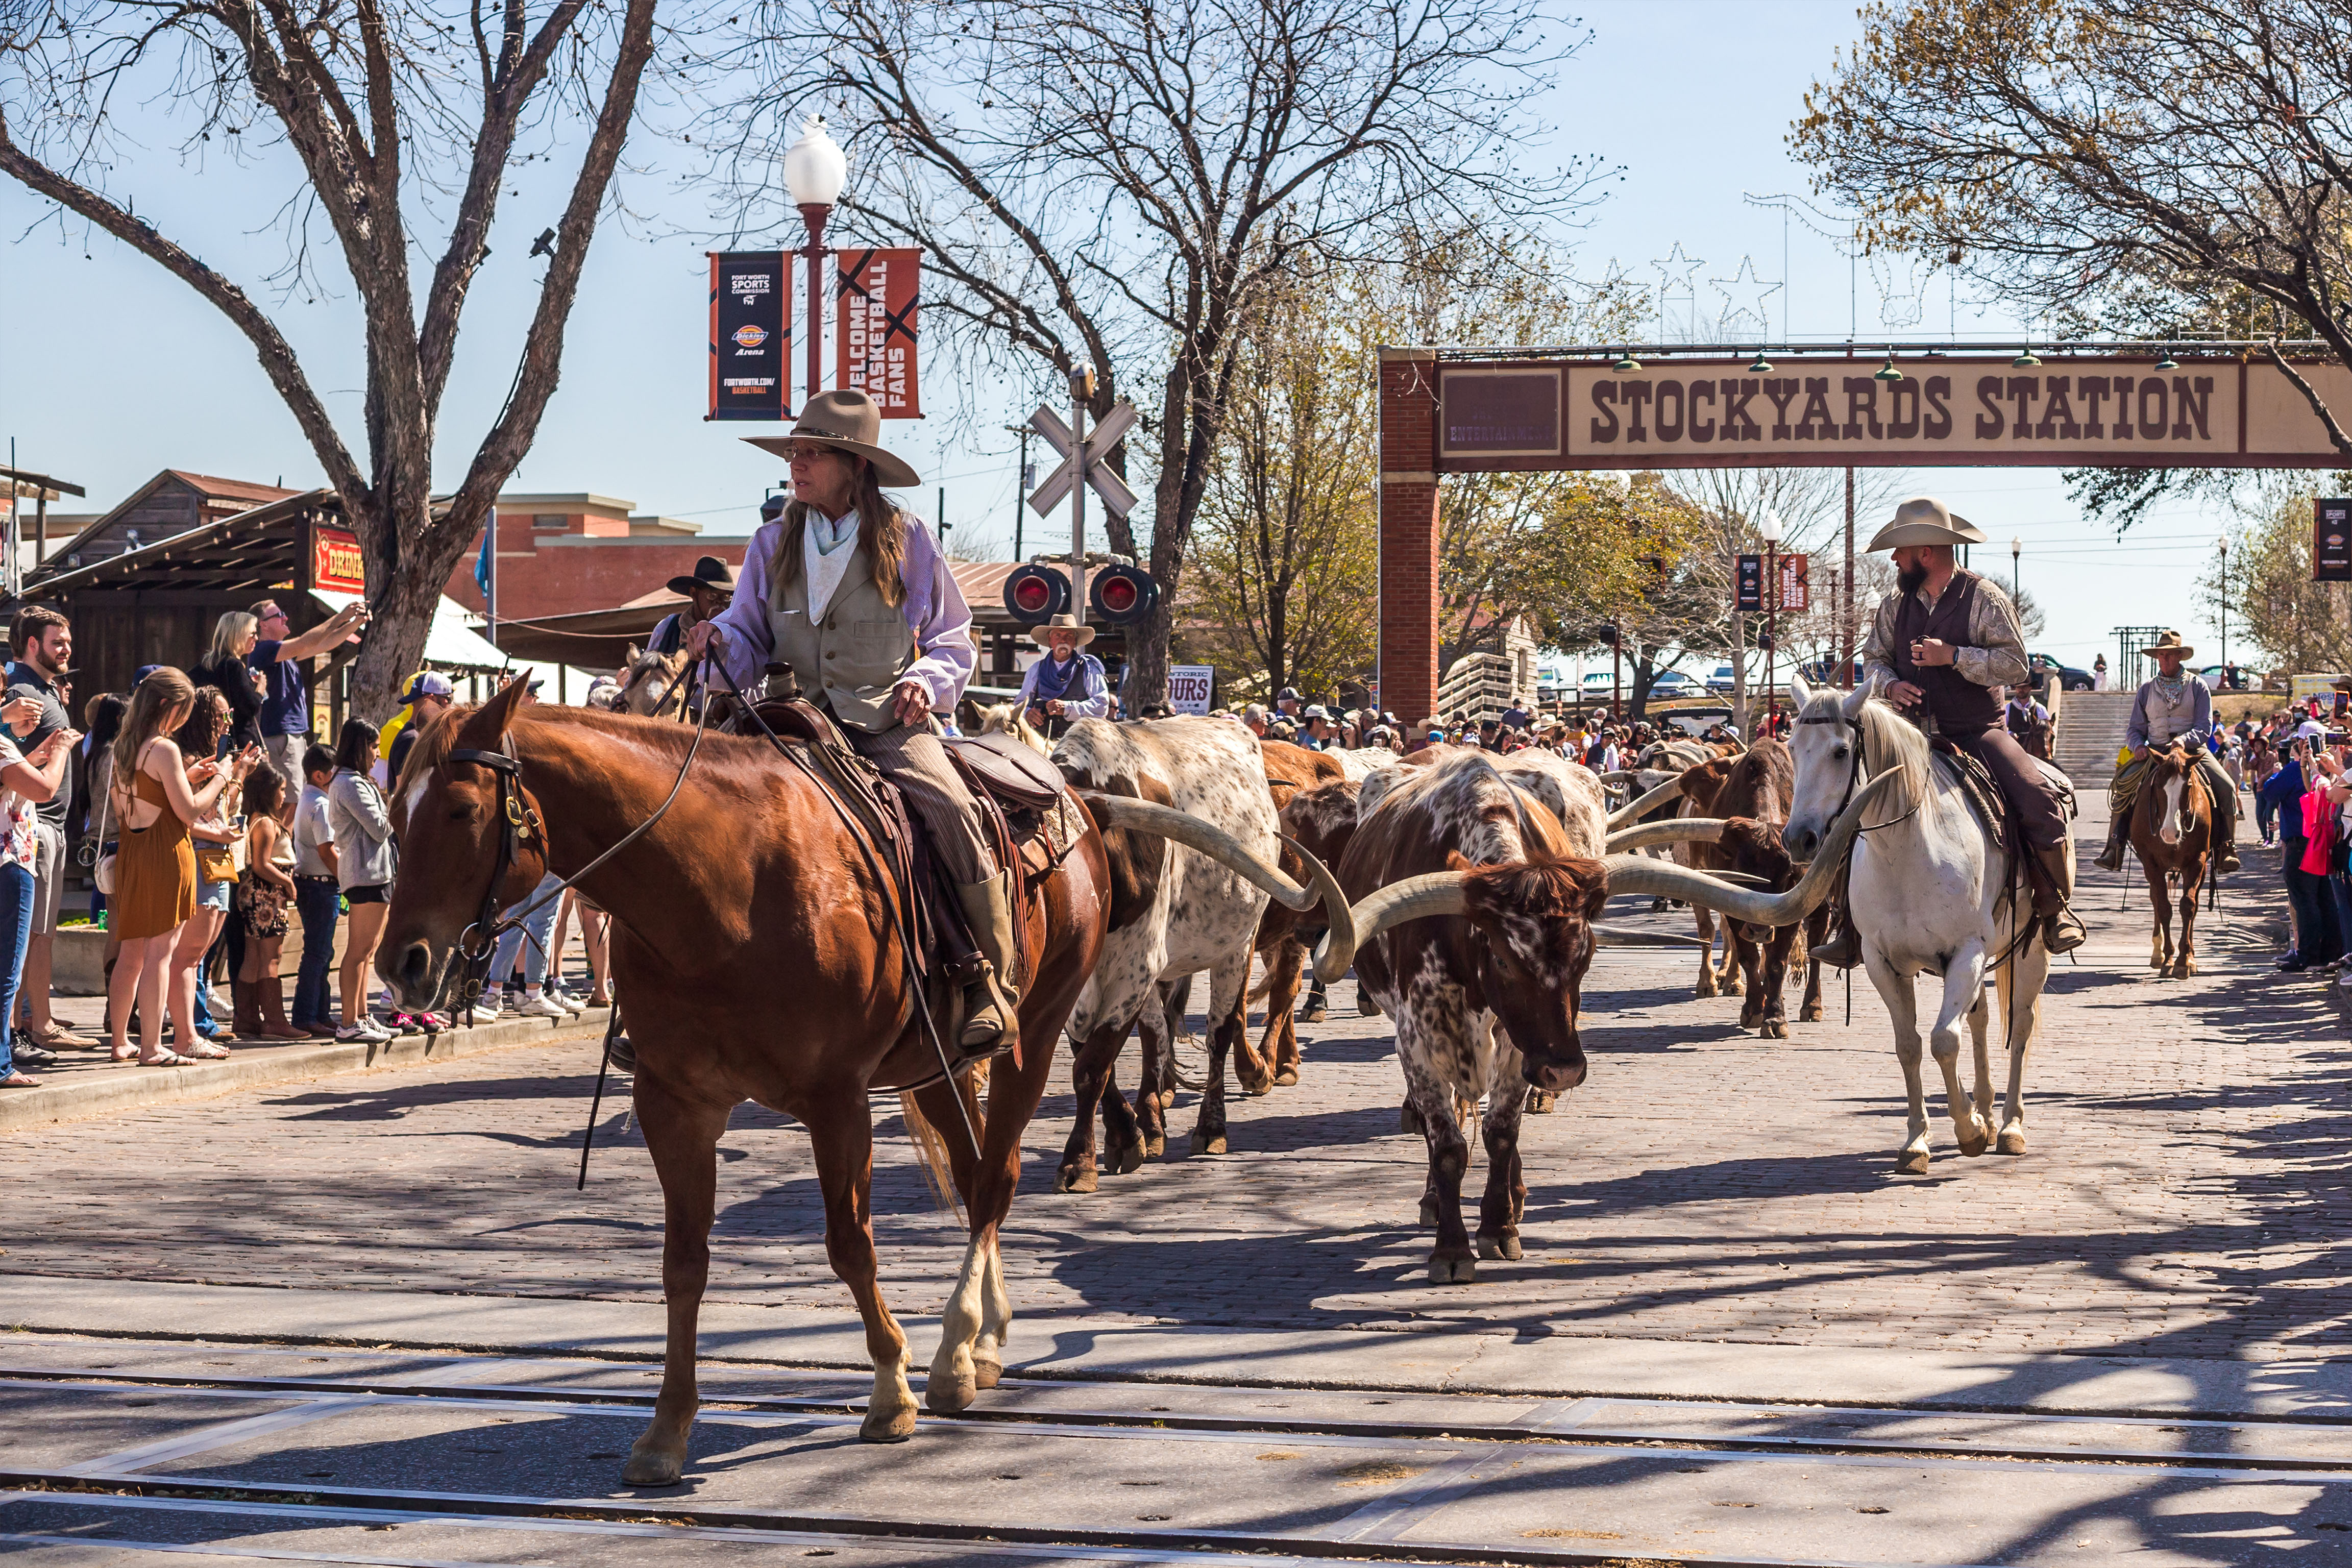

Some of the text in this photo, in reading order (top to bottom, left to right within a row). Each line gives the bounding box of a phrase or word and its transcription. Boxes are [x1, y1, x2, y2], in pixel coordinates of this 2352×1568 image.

[732, 280, 770, 289] SPORTS
[869, 261, 887, 407] BASKETBALL
[724, 378, 775, 386] FORTWORTH.COM/
[732, 386, 767, 395] BASKETBALL
[888, 348, 906, 407] FANS
[1591, 376, 2214, 443] STOCKYARDS STATION
